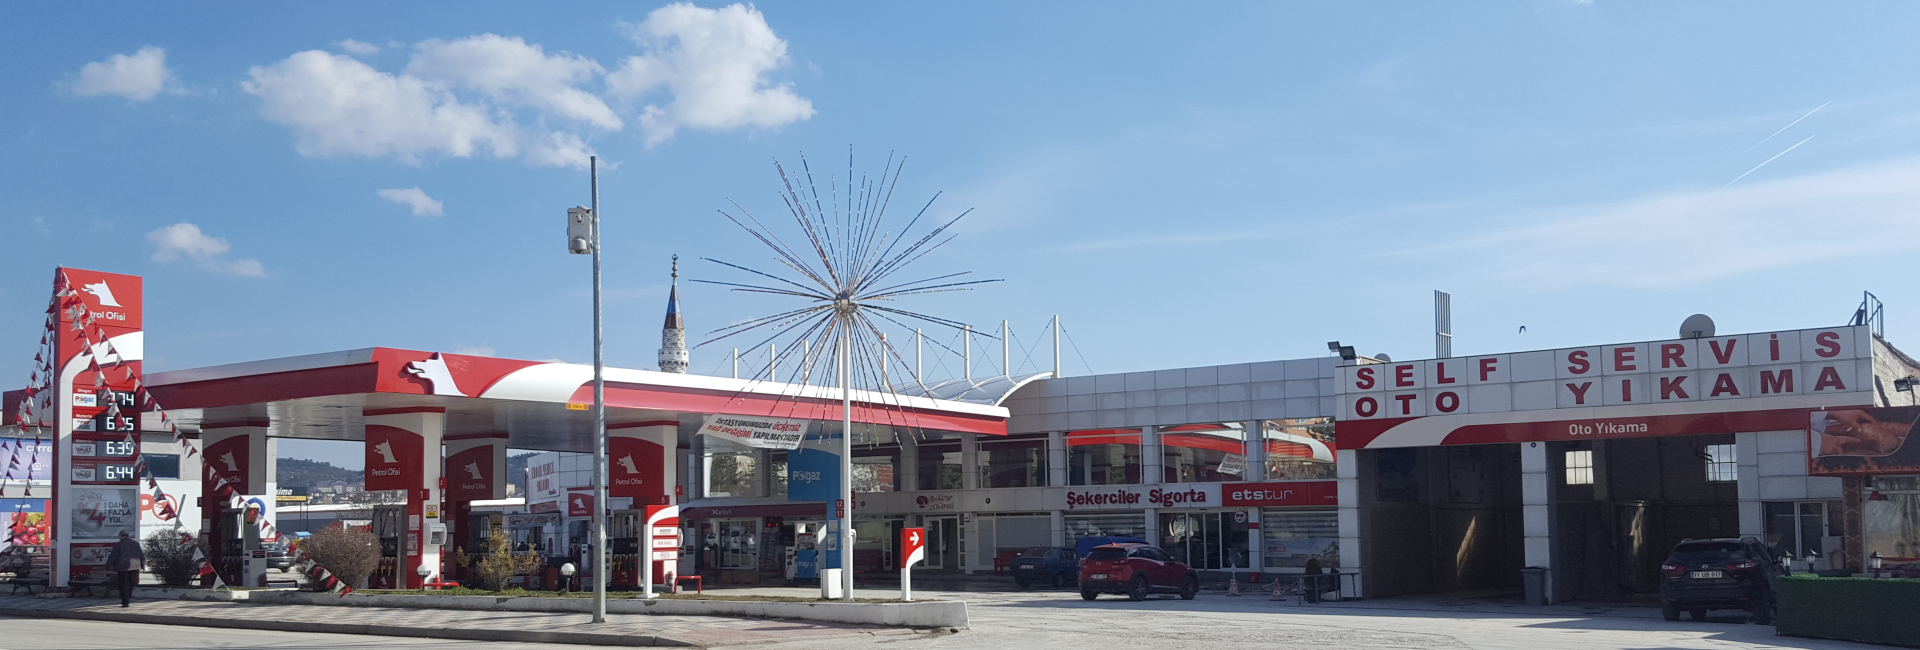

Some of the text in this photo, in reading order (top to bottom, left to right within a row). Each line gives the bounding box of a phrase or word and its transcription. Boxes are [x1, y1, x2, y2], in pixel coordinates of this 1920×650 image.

[79, 310, 126, 321] Ptrol Ofisi
[1355, 331, 1841, 390] SELF SERVİS
[1354, 366, 1847, 418] OTO YIKAMA
[1568, 422, 1648, 435] Oto Yıkama
[106, 465, 134, 479] 6.44
[371, 467, 401, 476] Petrol Ofisi
[615, 477, 643, 486] Petrol Ofisi
[1066, 488, 1206, 509] Şekerciler Sigorta
[1231, 488, 1293, 501] etstur
[108, 501, 129, 509] DAHA
